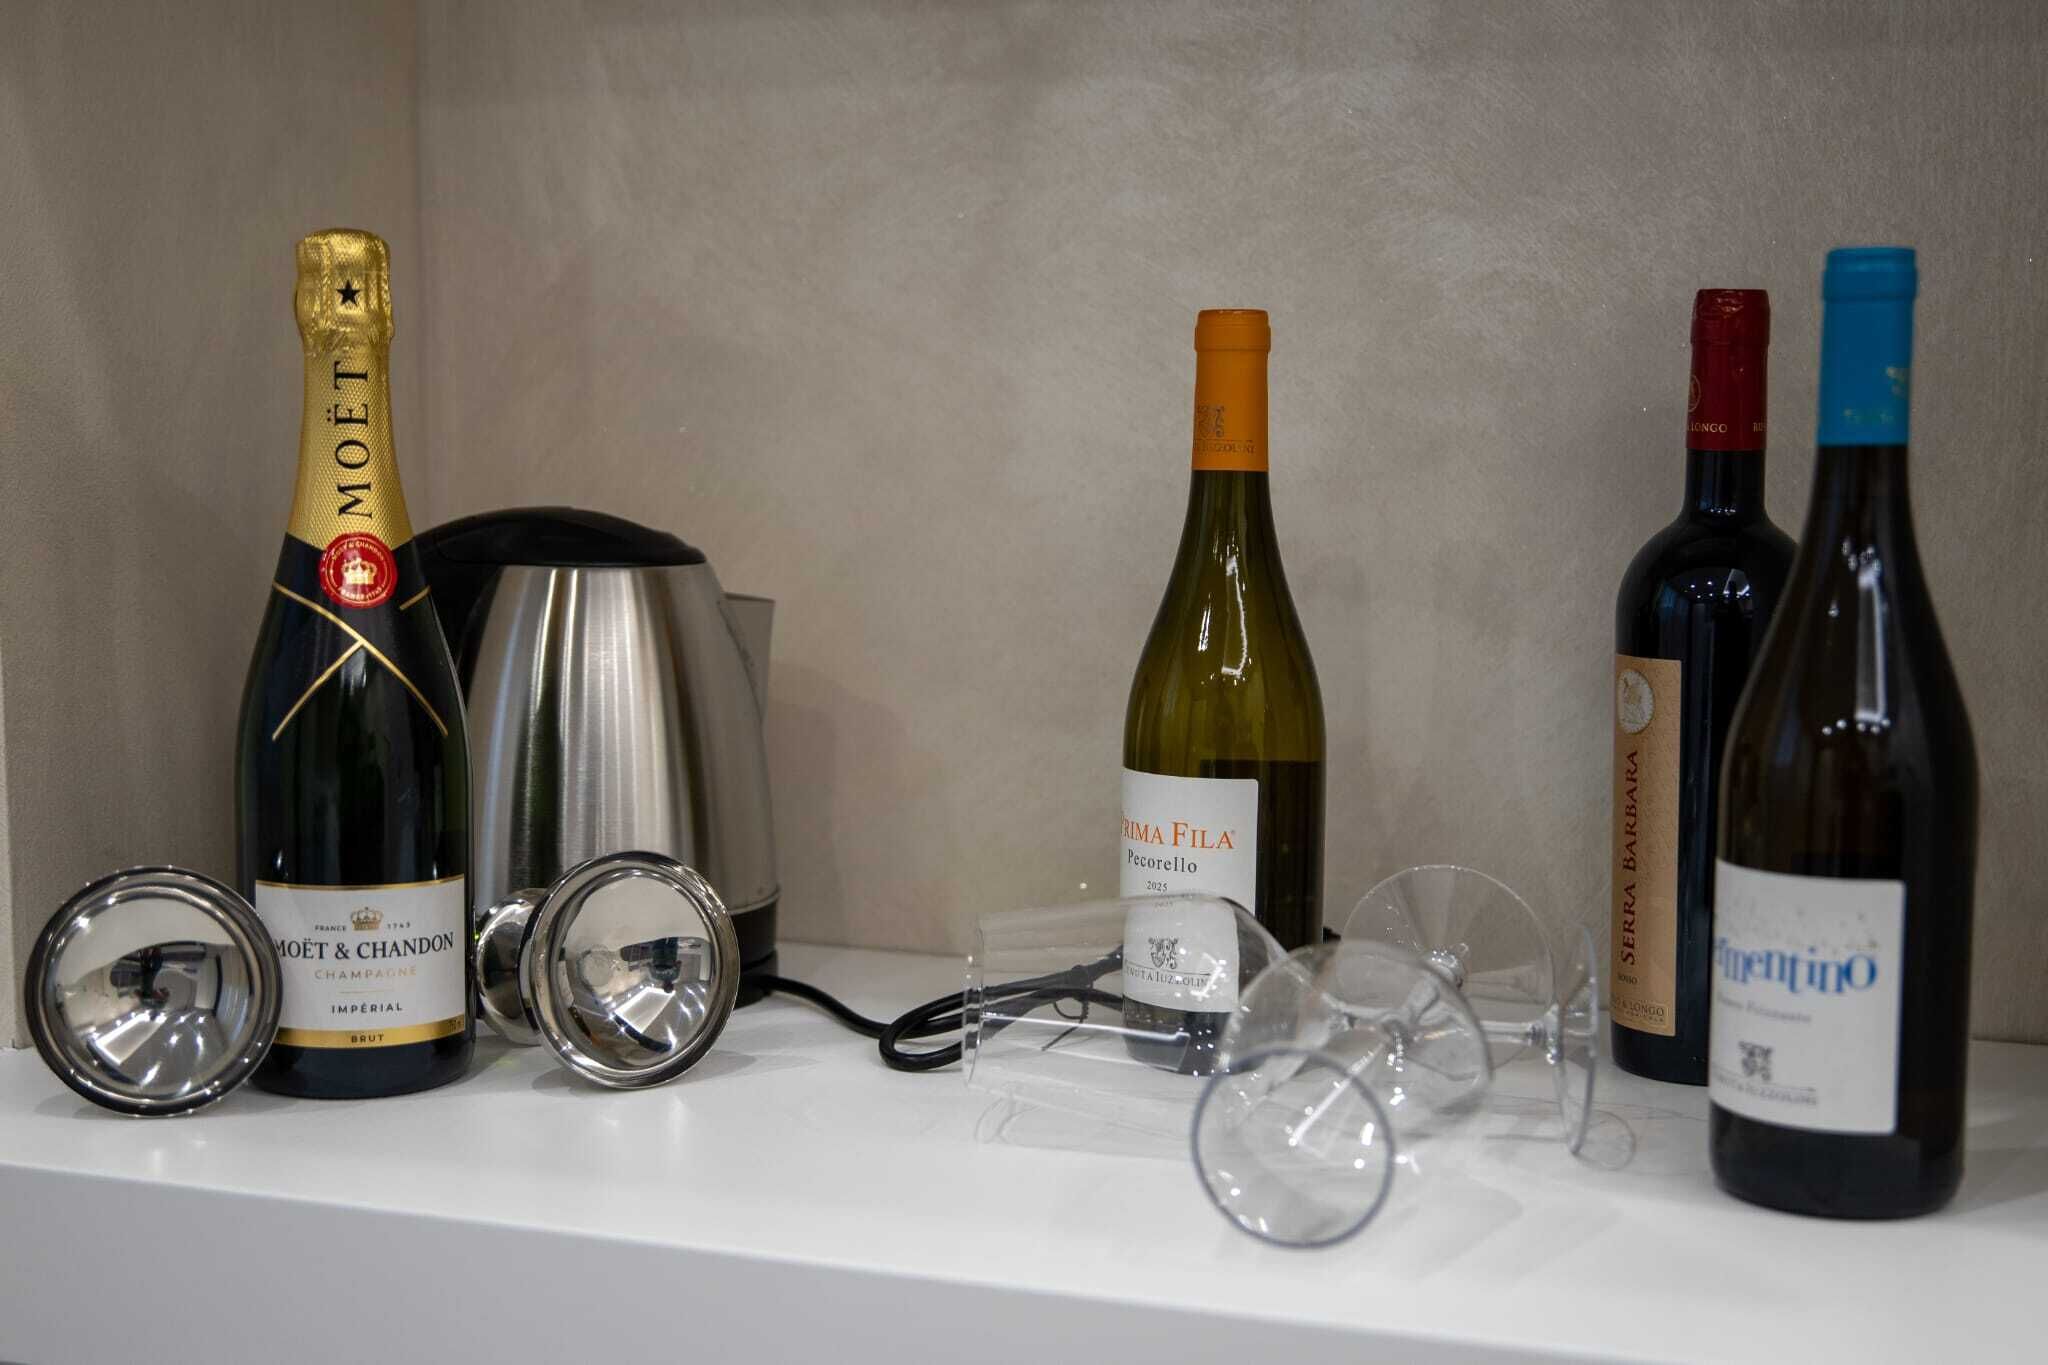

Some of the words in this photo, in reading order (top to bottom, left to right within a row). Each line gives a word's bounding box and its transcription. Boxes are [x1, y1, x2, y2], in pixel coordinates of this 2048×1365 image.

[327, 360, 372, 519] MOËT
[1623, 750, 1638, 872] BARBARA
[1172, 821, 1234, 849] FILA
[1127, 849, 1198, 874] Pecorello
[1146, 880, 1168, 893] 2025
[314, 924, 347, 932] FRANCE
[1622, 883, 1636, 965] SERRA
[274, 938, 329, 960] MOËT
[335, 943, 350, 960] &
[356, 932, 454, 960] CHANDON
[314, 967, 417, 980] CHAMPAGNE
[331, 1003, 403, 1014] IMPÉRIAL
[351, 1033, 385, 1043] BRUT
